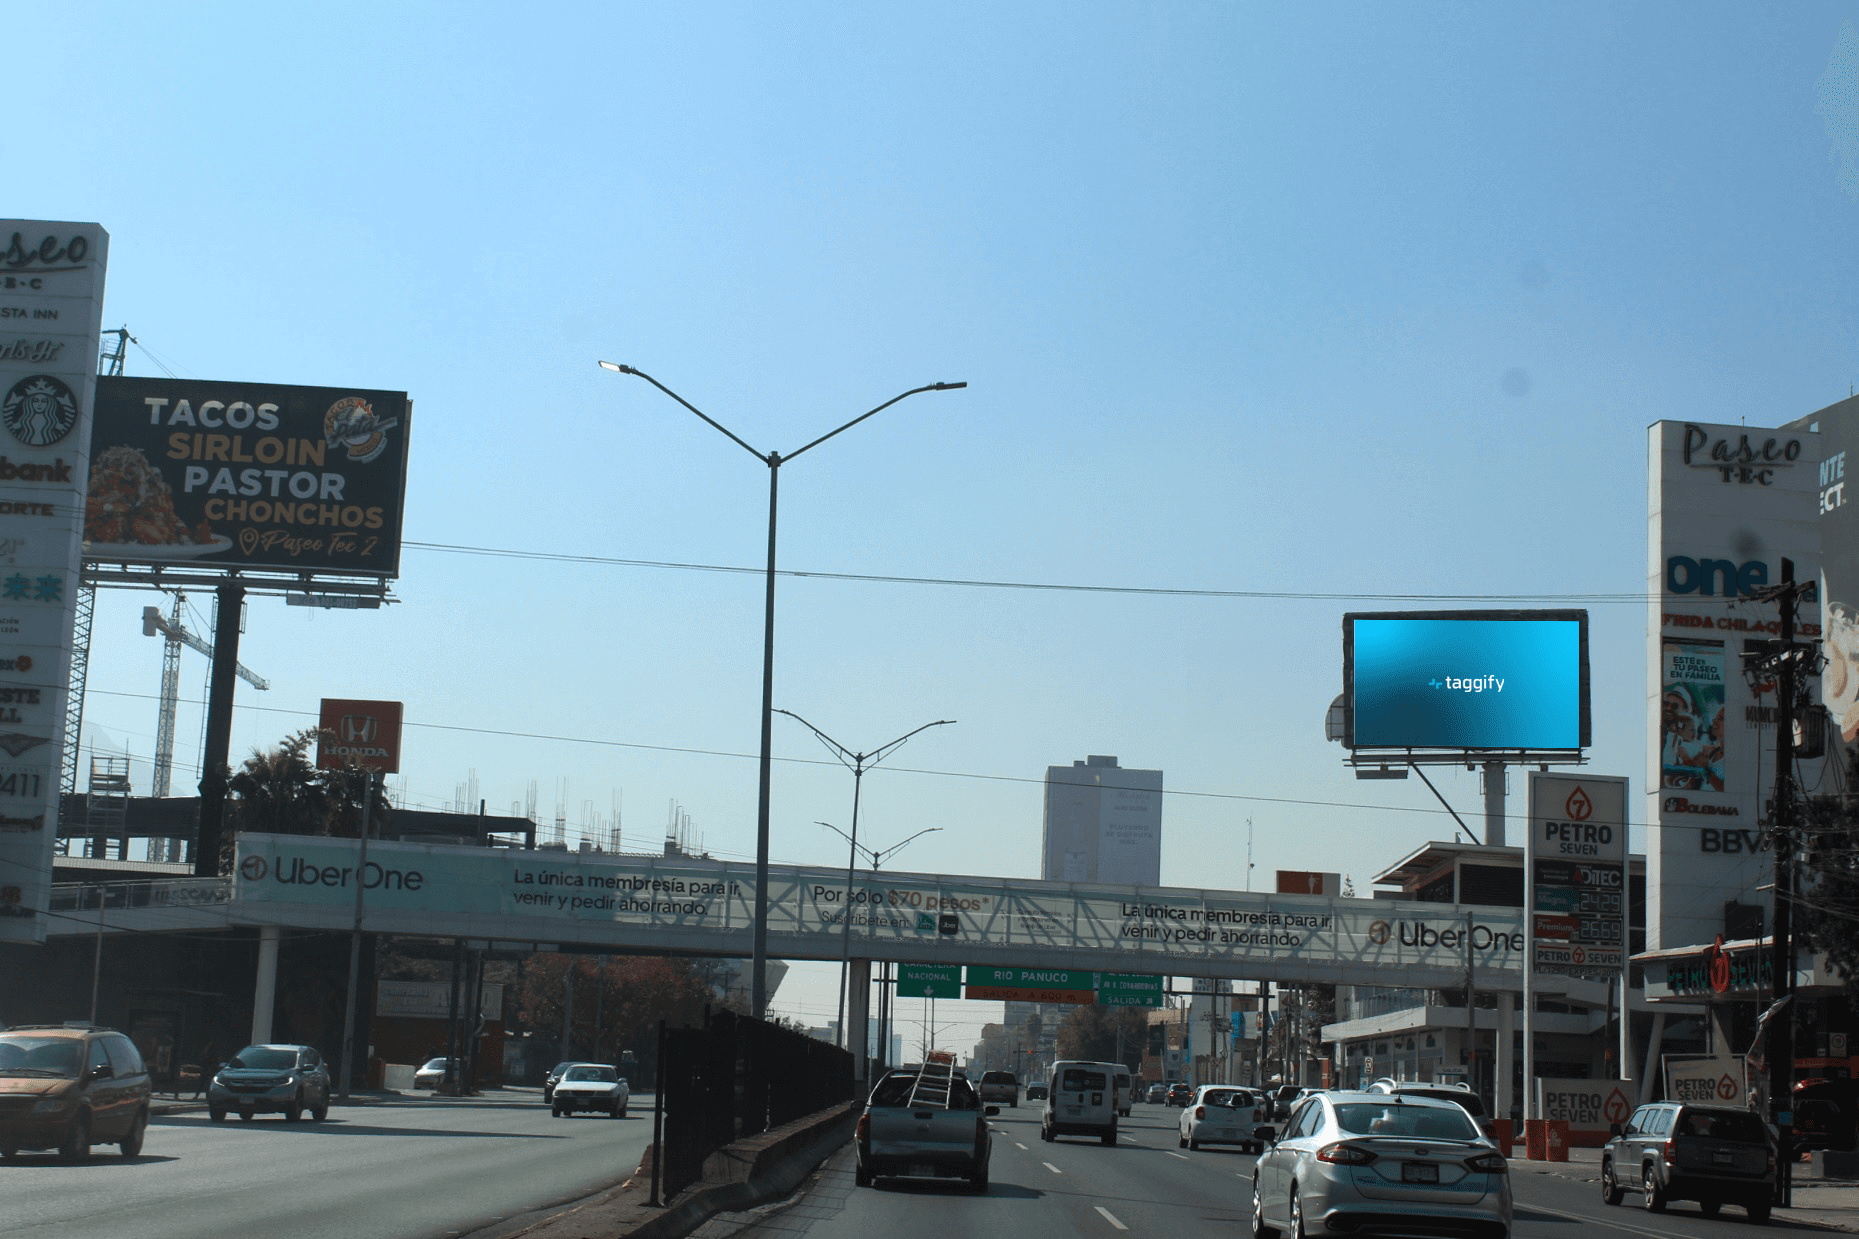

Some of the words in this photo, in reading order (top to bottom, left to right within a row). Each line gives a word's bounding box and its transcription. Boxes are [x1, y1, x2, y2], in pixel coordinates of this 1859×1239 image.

[0, 231, 88, 268] seo
[33, 308, 59, 320] INN
[144, 396, 280, 431] TACOS
[167, 432, 326, 467] SIRLOIN
[1684, 424, 1801, 466] Paseo
[184, 465, 346, 501] PASTOR
[204, 498, 384, 529] CHONCHOS
[261, 529, 324, 557] Paseo
[328, 531, 358, 556] Tec
[361, 536, 379, 556] 2
[1668, 555, 1769, 598] one
[1673, 656, 1695, 664] ESTE
[1688, 664, 1718, 673] PASEO
[1445, 675, 1505, 693] taggify
[1670, 670, 1683, 678] EN
[1685, 671, 1721, 681] FAMILIA
[323, 746, 391, 757] HONDA
[1546, 822, 1612, 845] PETRO
[1560, 842, 1598, 856] SEVEN
[275, 856, 353, 888] Uber
[356, 861, 424, 891] One
[514, 869, 535, 885] La
[538, 870, 584, 887] única
[588, 875, 685, 894] membresía
[689, 881, 725, 897] para
[513, 890, 553, 906] venir
[557, 894, 569, 910] y
[571, 892, 616, 912] pedir
[618, 897, 708, 916] ahorrando.
[814, 886, 844, 903] Por
[848, 887, 884, 904] sólo
[889, 890, 923, 907] $70
[821, 910, 888, 928] Suscríbete
[1121, 902, 1141, 918] La
[1144, 903, 1185, 921] única
[1190, 908, 1280, 927] membresía
[1284, 914, 1318, 929] para
[1121, 924, 1160, 941] venir
[1163, 927, 1172, 942] y
[1175, 926, 1217, 946] pedir
[1220, 929, 1302, 948] ahorrando.
[1400, 921, 1466, 950] Uber
[1470, 924, 1524, 952] One
[1537, 951, 1571, 962] PETRO
[1588, 953, 1622, 964] SEVEN
[907, 971, 952, 981] NACIONAL
[994, 970, 1013, 980] RIO
[1021, 971, 1069, 983] PANUCO
[983, 989, 1019, 999] SALIDA
[1107, 996, 1142, 1005] SALIDA
[1675, 1079, 1716, 1092] PETRO
[1546, 1091, 1602, 1110] PETRO
[1678, 1090, 1714, 1101] SEVEN
[1550, 1109, 1598, 1124] SEVEN
